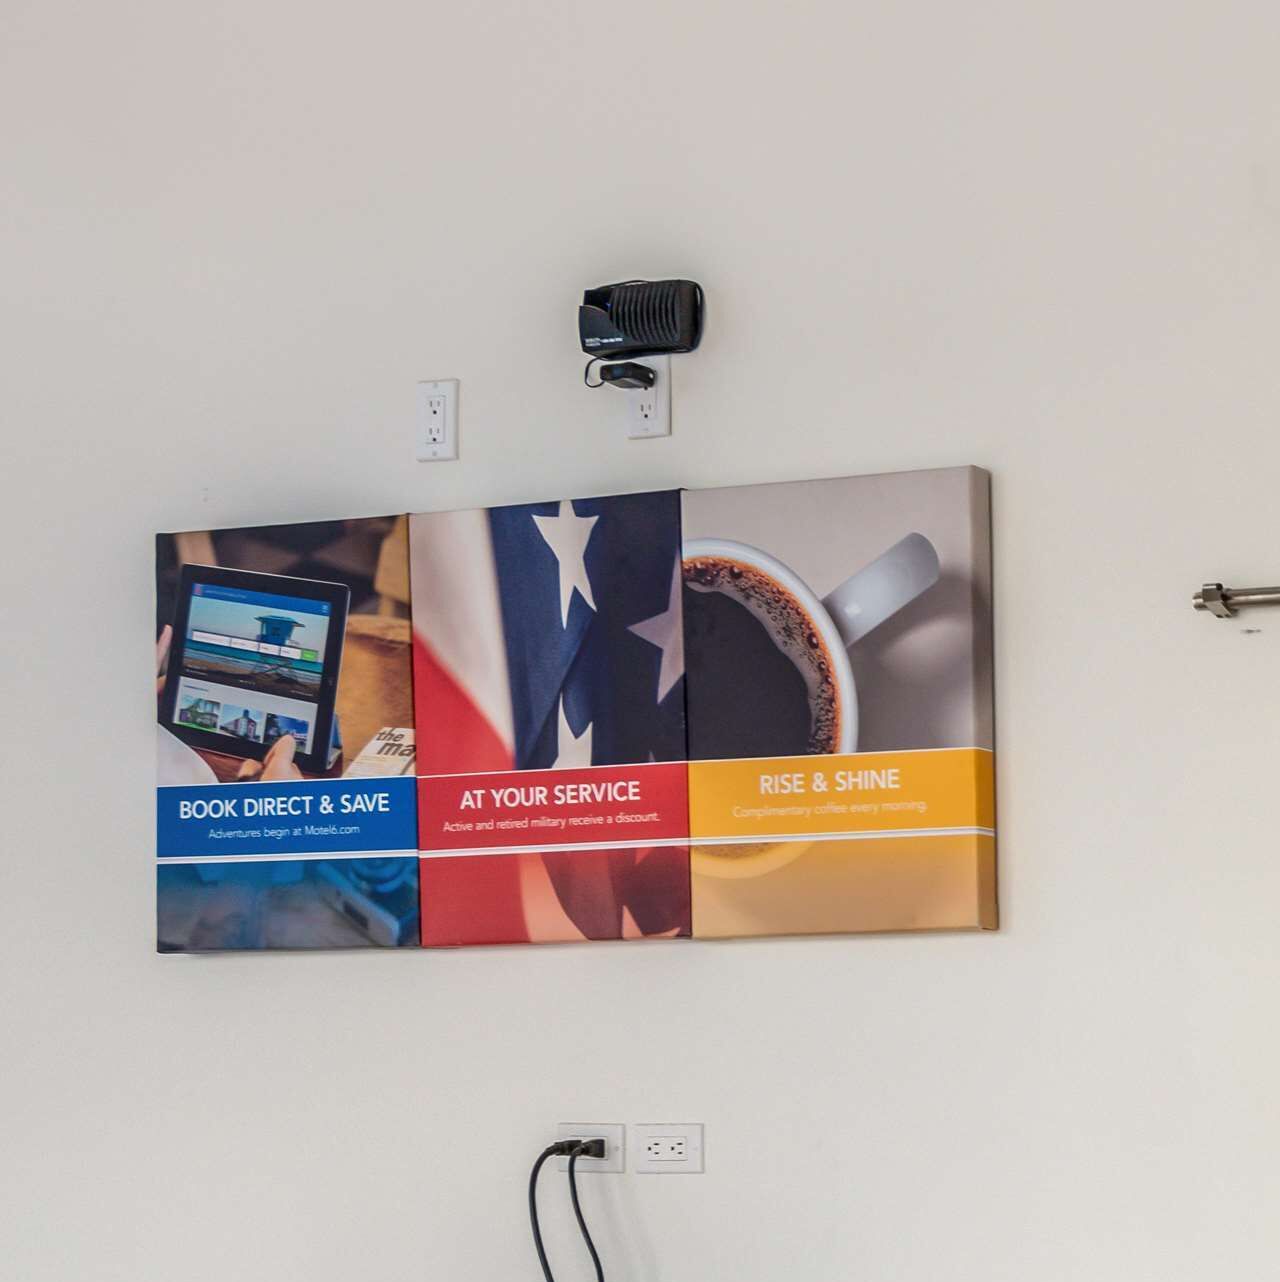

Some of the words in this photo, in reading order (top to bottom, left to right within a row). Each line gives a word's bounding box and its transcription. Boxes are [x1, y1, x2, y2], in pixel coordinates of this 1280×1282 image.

[376, 727, 405, 742] the
[759, 774, 805, 795] RISE
[812, 772, 828, 792] &
[835, 768, 900, 792] SHINE
[460, 789, 485, 810] AT
[491, 786, 548, 808] YOUR
[554, 780, 640, 806] SERVICE
[179, 799, 238, 819] BOOK
[244, 796, 313, 817] DIRECT
[319, 795, 334, 814] &
[340, 793, 390, 813] SAVE
[732, 804, 812, 819] Complimentary
[815, 801, 848, 815] coffee
[850, 803, 879, 815] every
[208, 828, 261, 840] Adventures
[264, 826, 290, 840] begin
[293, 826, 302, 837] at
[305, 824, 360, 836] Motel6.com
[443, 820, 472, 832] Active
[475, 819, 493, 831] and
[496, 817, 528, 830] retired
[531, 815, 566, 831] military
[569, 814, 603, 826] receive
[607, 815, 613, 824] a
[616, 811, 661, 824] discount.
